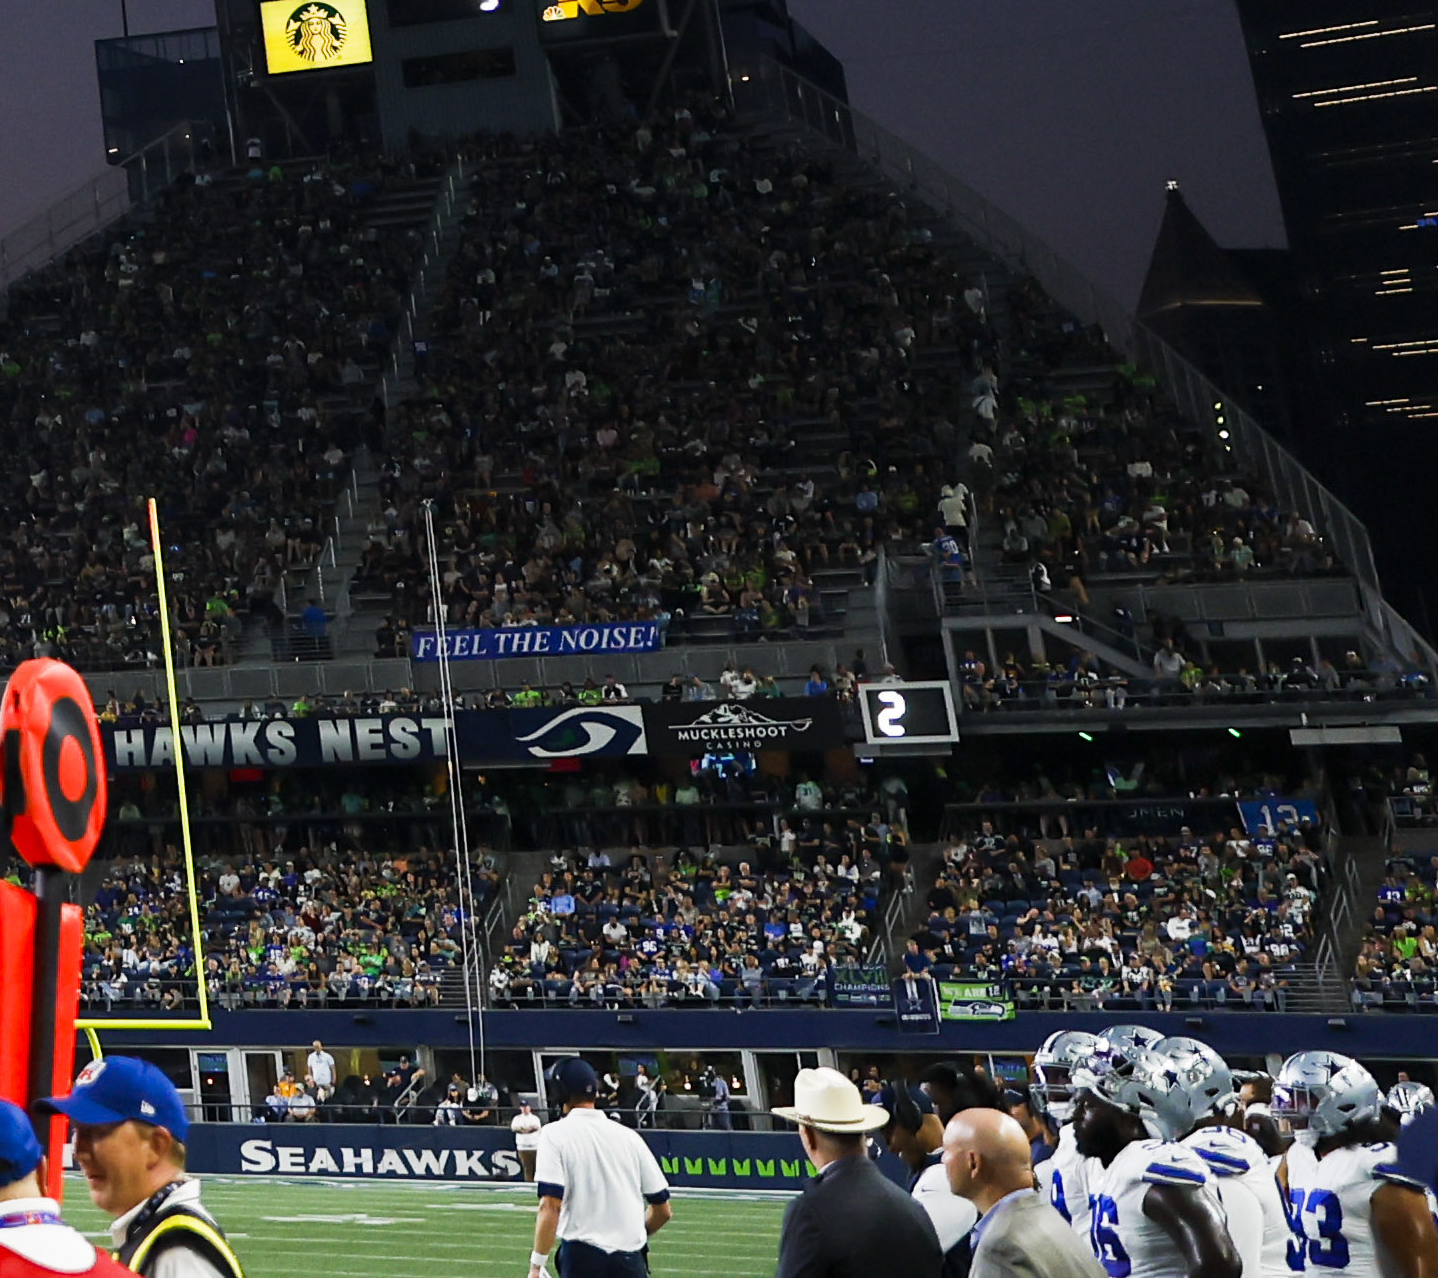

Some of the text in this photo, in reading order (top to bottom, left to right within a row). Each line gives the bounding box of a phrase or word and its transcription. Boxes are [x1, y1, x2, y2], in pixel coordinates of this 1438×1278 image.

[416, 623, 658, 659] FEEL THE NOISE!
[878, 690, 907, 737] 2
[114, 717, 454, 766] HAWKS NEST
[678, 727, 788, 741] MUCKLESHOOT
[706, 740, 762, 750] CASINO
[835, 983, 891, 991] CHAMPIONS
[241, 1139, 521, 1178] SEAHAWKS
